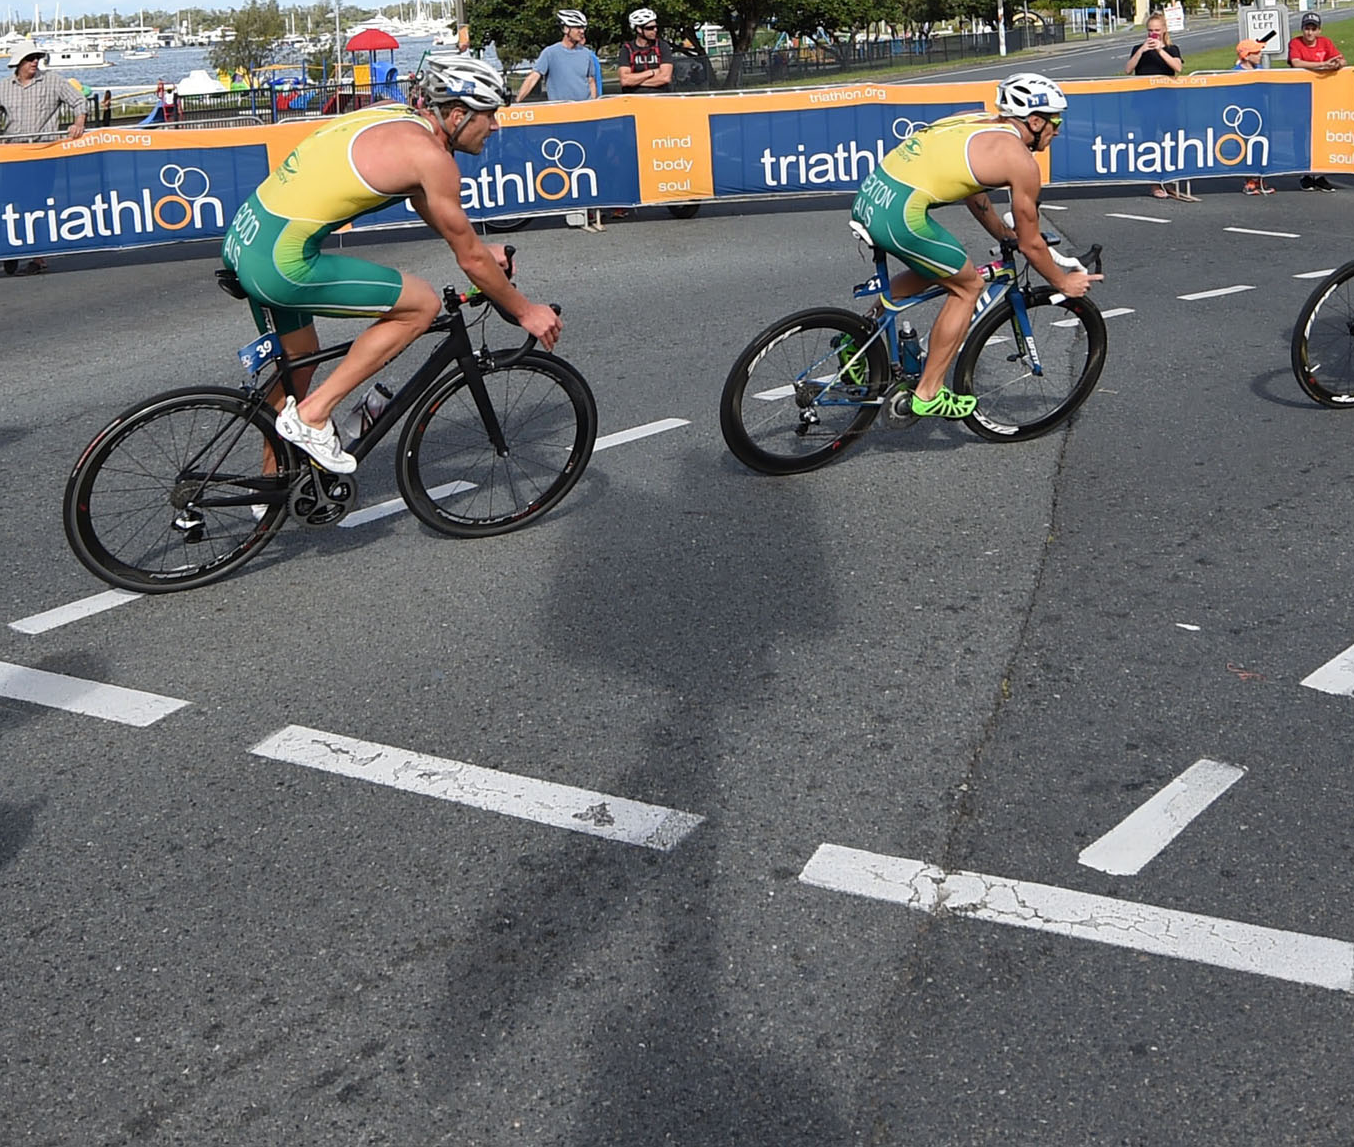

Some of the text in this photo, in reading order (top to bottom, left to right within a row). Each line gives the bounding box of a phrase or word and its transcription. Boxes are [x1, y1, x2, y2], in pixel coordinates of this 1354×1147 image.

[1251, 12, 1274, 21] KEEP
[1253, 21, 1273, 30] LEFT
[809, 86, 887, 104] triathlon.org
[652, 135, 692, 149] mind
[1092, 127, 1269, 174] triathlon
[653, 157, 693, 173] body
[761, 139, 884, 186] triathl
[1329, 152, 1354, 165] soul
[459, 161, 597, 210] athlon
[658, 179, 691, 192] soul
[2, 188, 224, 247] triathlon
[853, 197, 874, 229] AUS
[232, 202, 261, 246] GOOD
[224, 234, 241, 272] AUS
[868, 279, 881, 290] 21
[256, 340, 273, 358] 39
